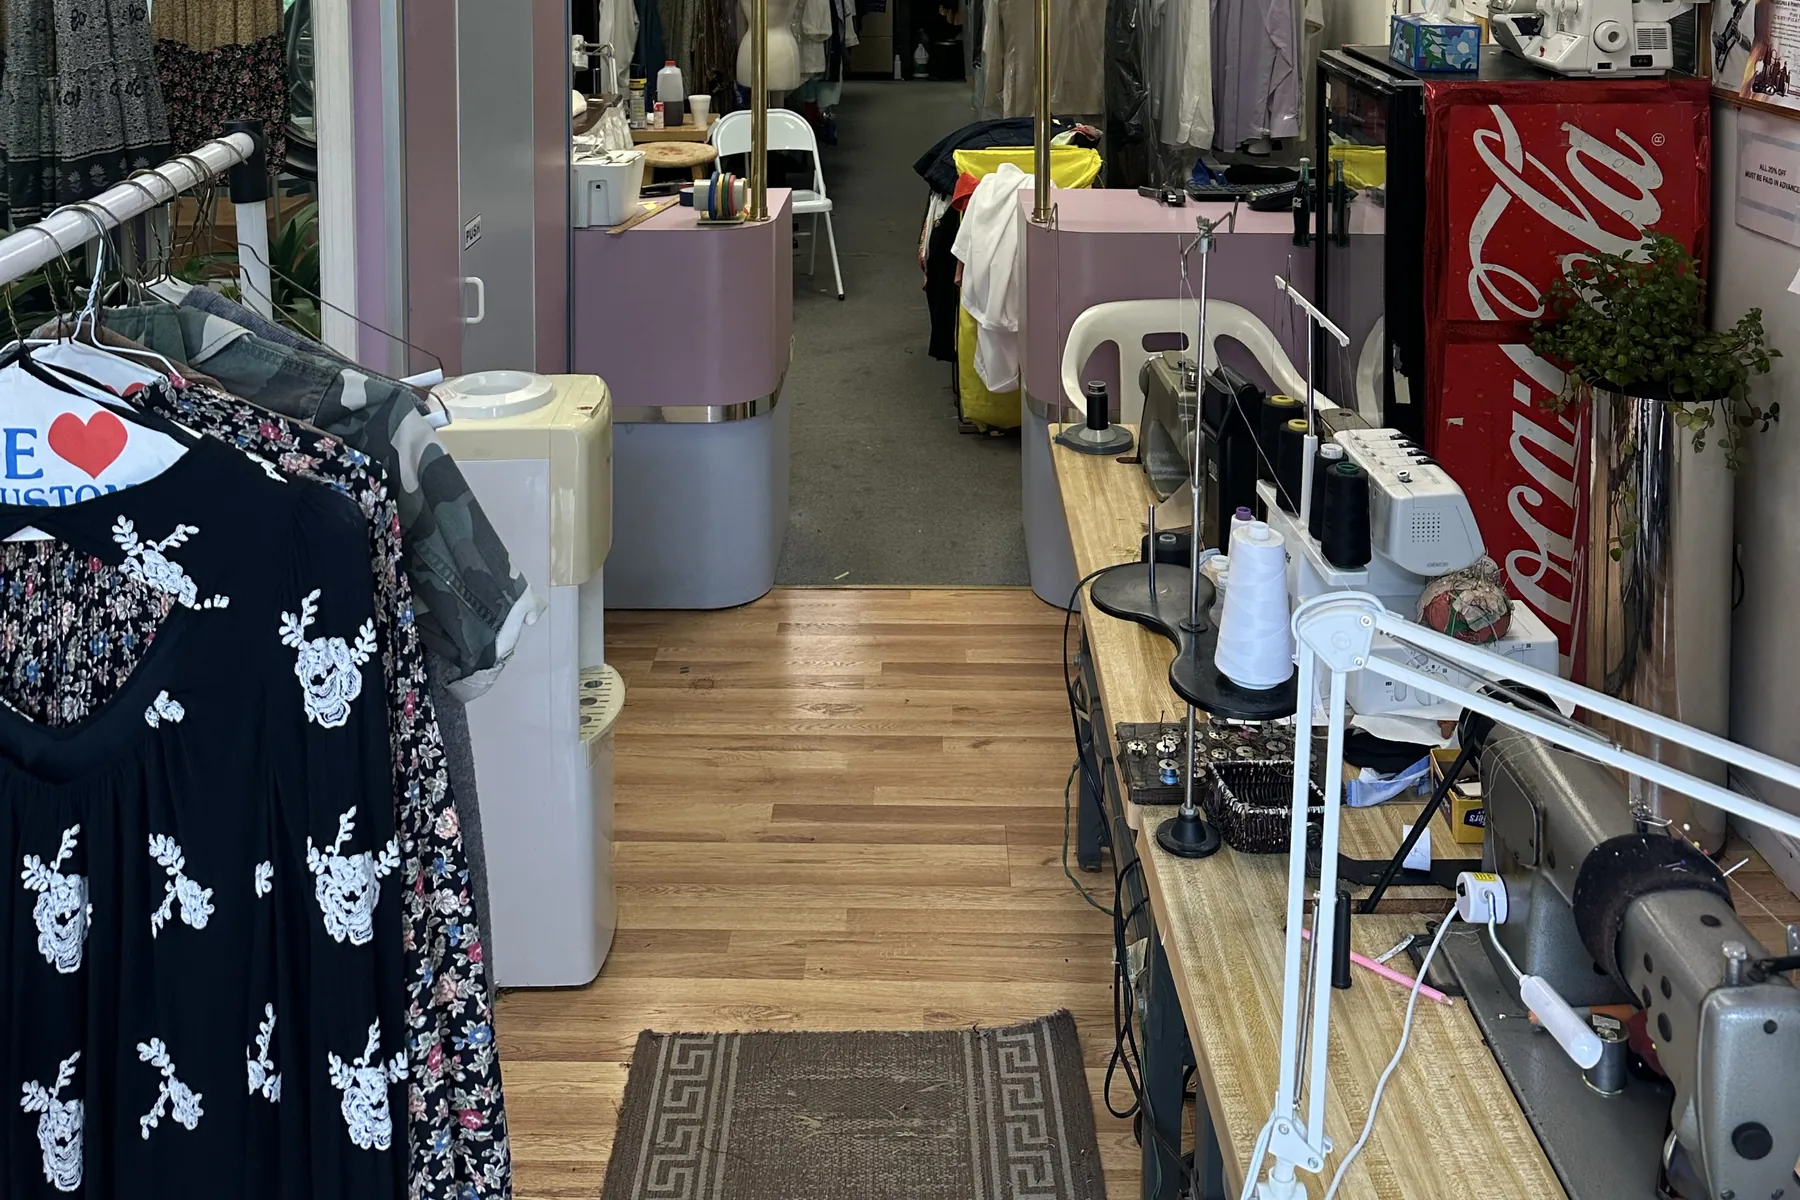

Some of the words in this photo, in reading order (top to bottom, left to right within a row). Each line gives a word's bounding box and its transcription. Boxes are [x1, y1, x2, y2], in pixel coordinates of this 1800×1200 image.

[1745, 170, 1756, 180] MUST
[1756, 174, 1762, 182] BE
[1763, 176, 1773, 185] PAID
[1774, 179, 1779, 187] IN
[1779, 181, 1800, 194] ADVANCE
[1759, 164, 1767, 172] ALL
[1778, 169, 1787, 177] OFF
[466, 221, 481, 243] PUSH
[3, 428, 43, 479] E
[0, 483, 136, 507] USTO
